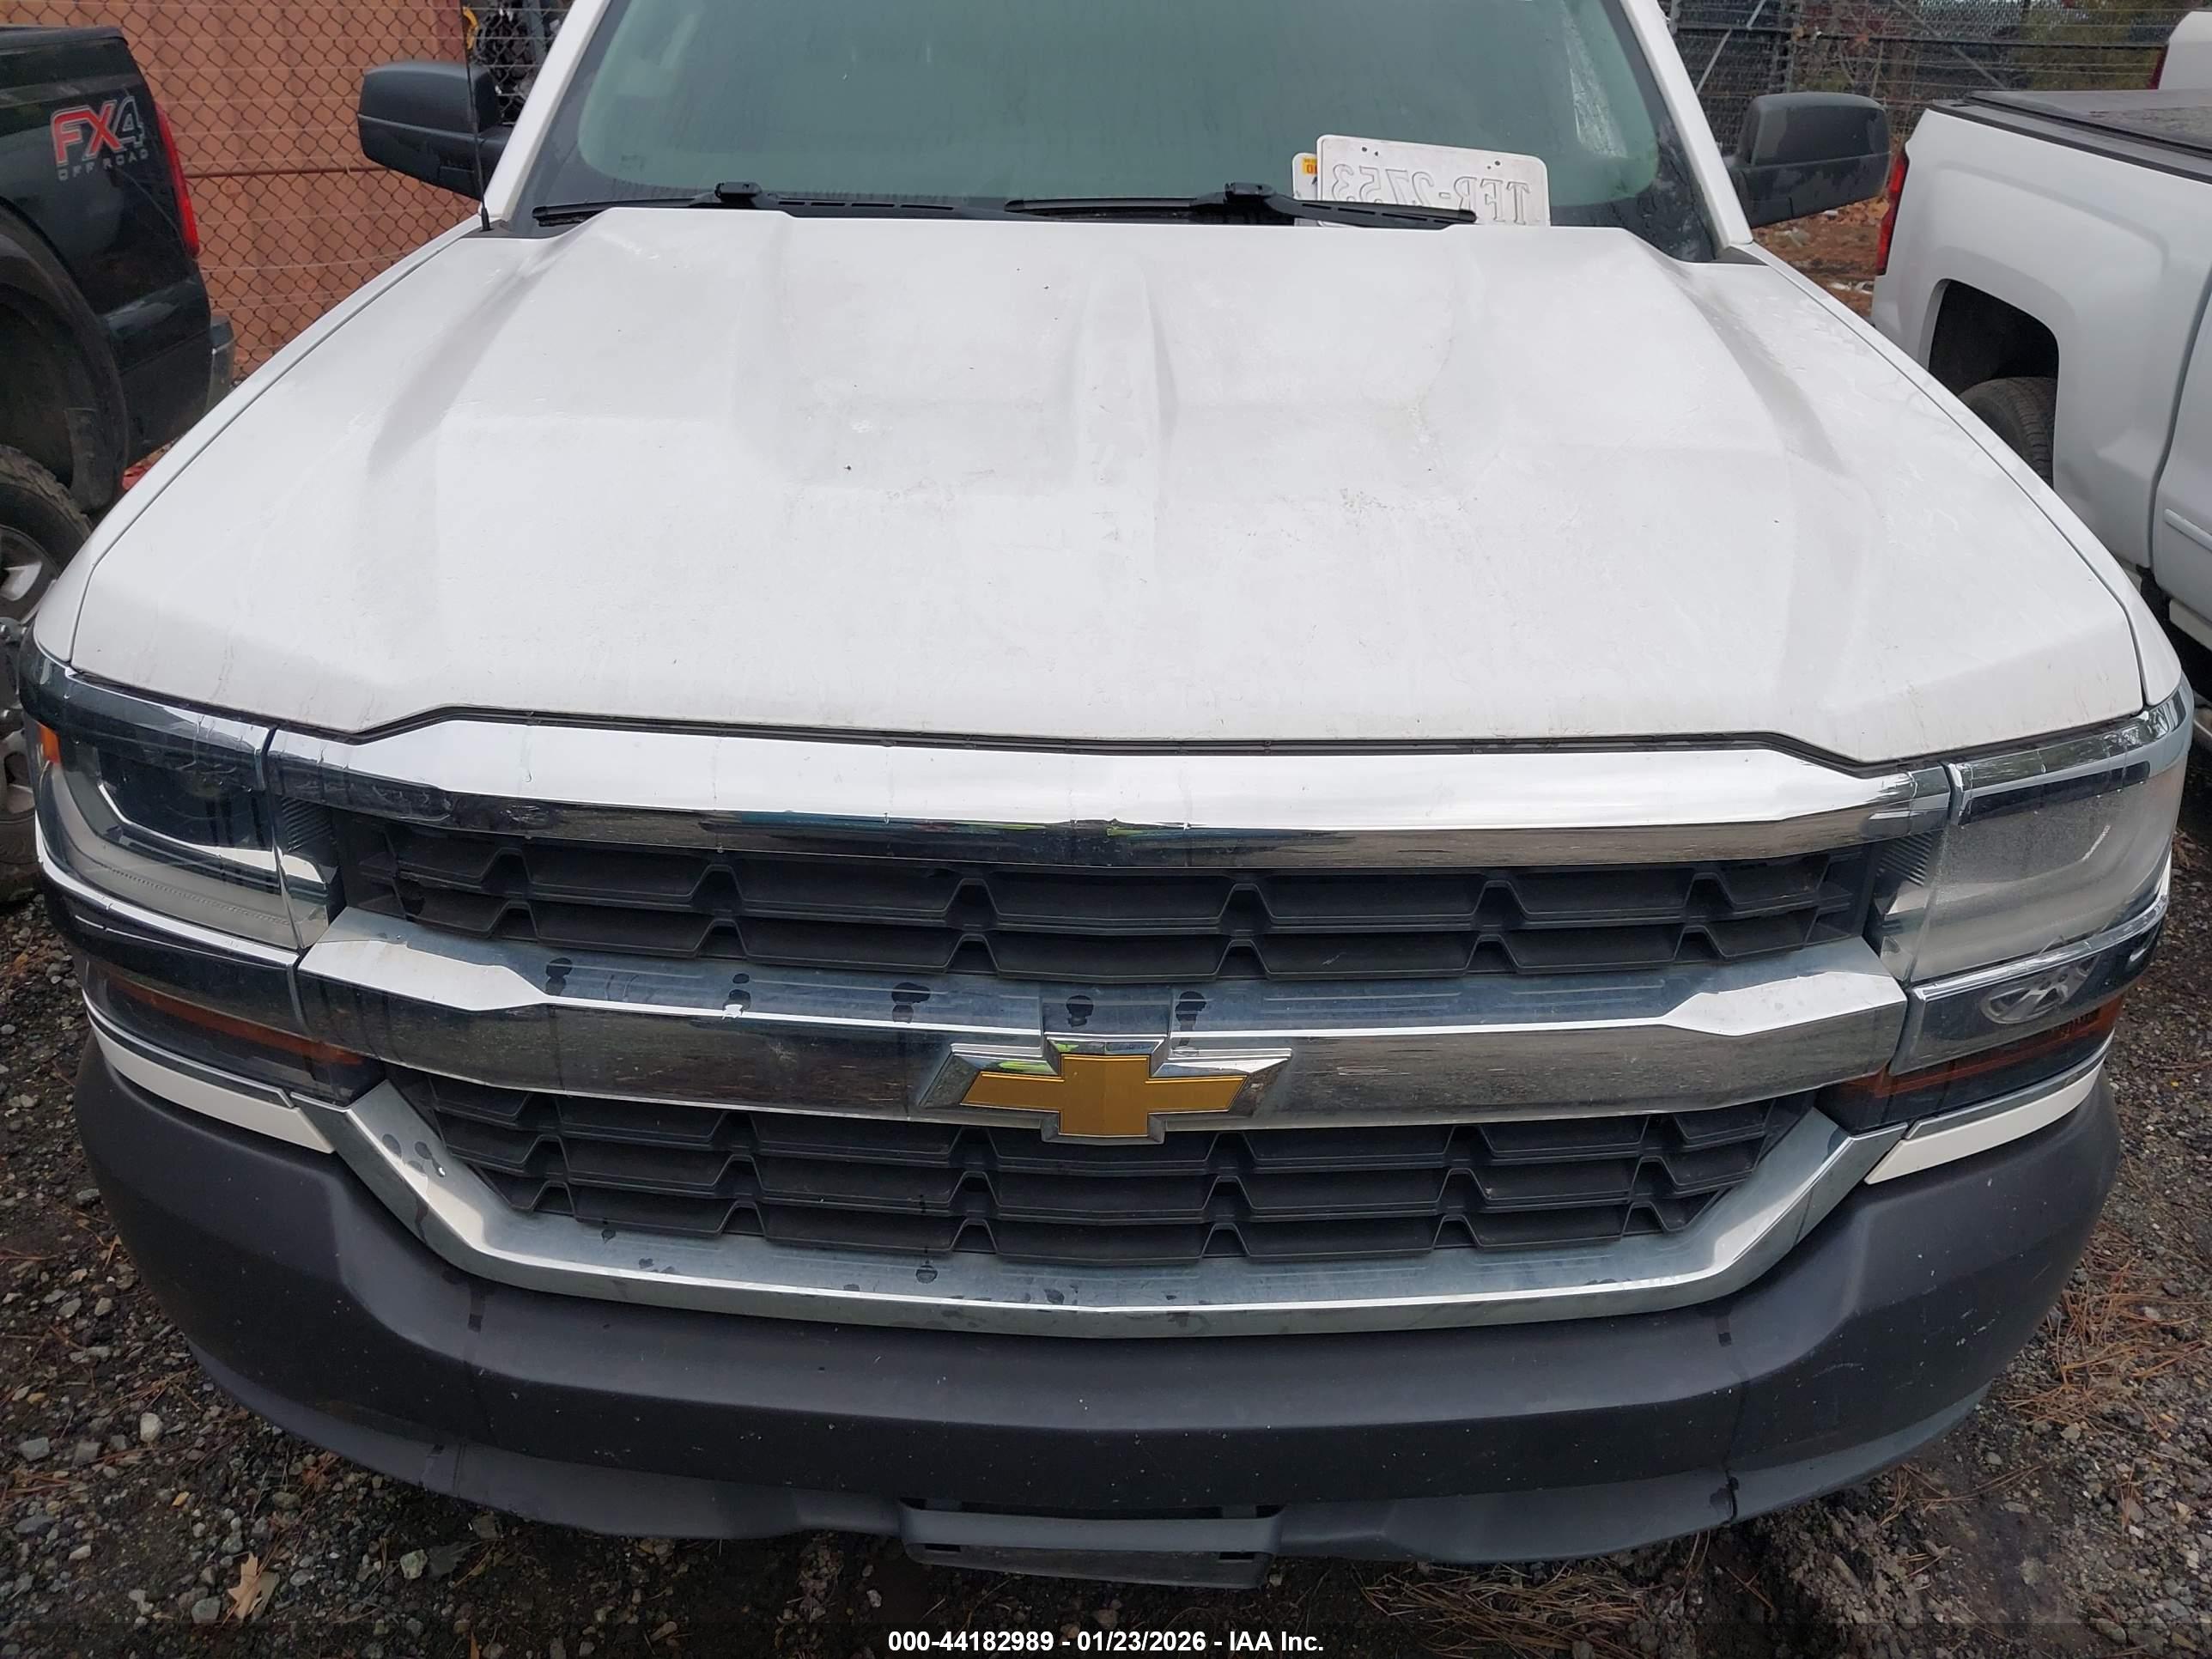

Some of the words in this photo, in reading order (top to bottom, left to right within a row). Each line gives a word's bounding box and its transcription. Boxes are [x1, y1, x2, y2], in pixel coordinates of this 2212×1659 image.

[51, 95, 144, 167] FX4
[58, 162, 95, 181] OFF
[103, 149, 149, 170] ROAD
